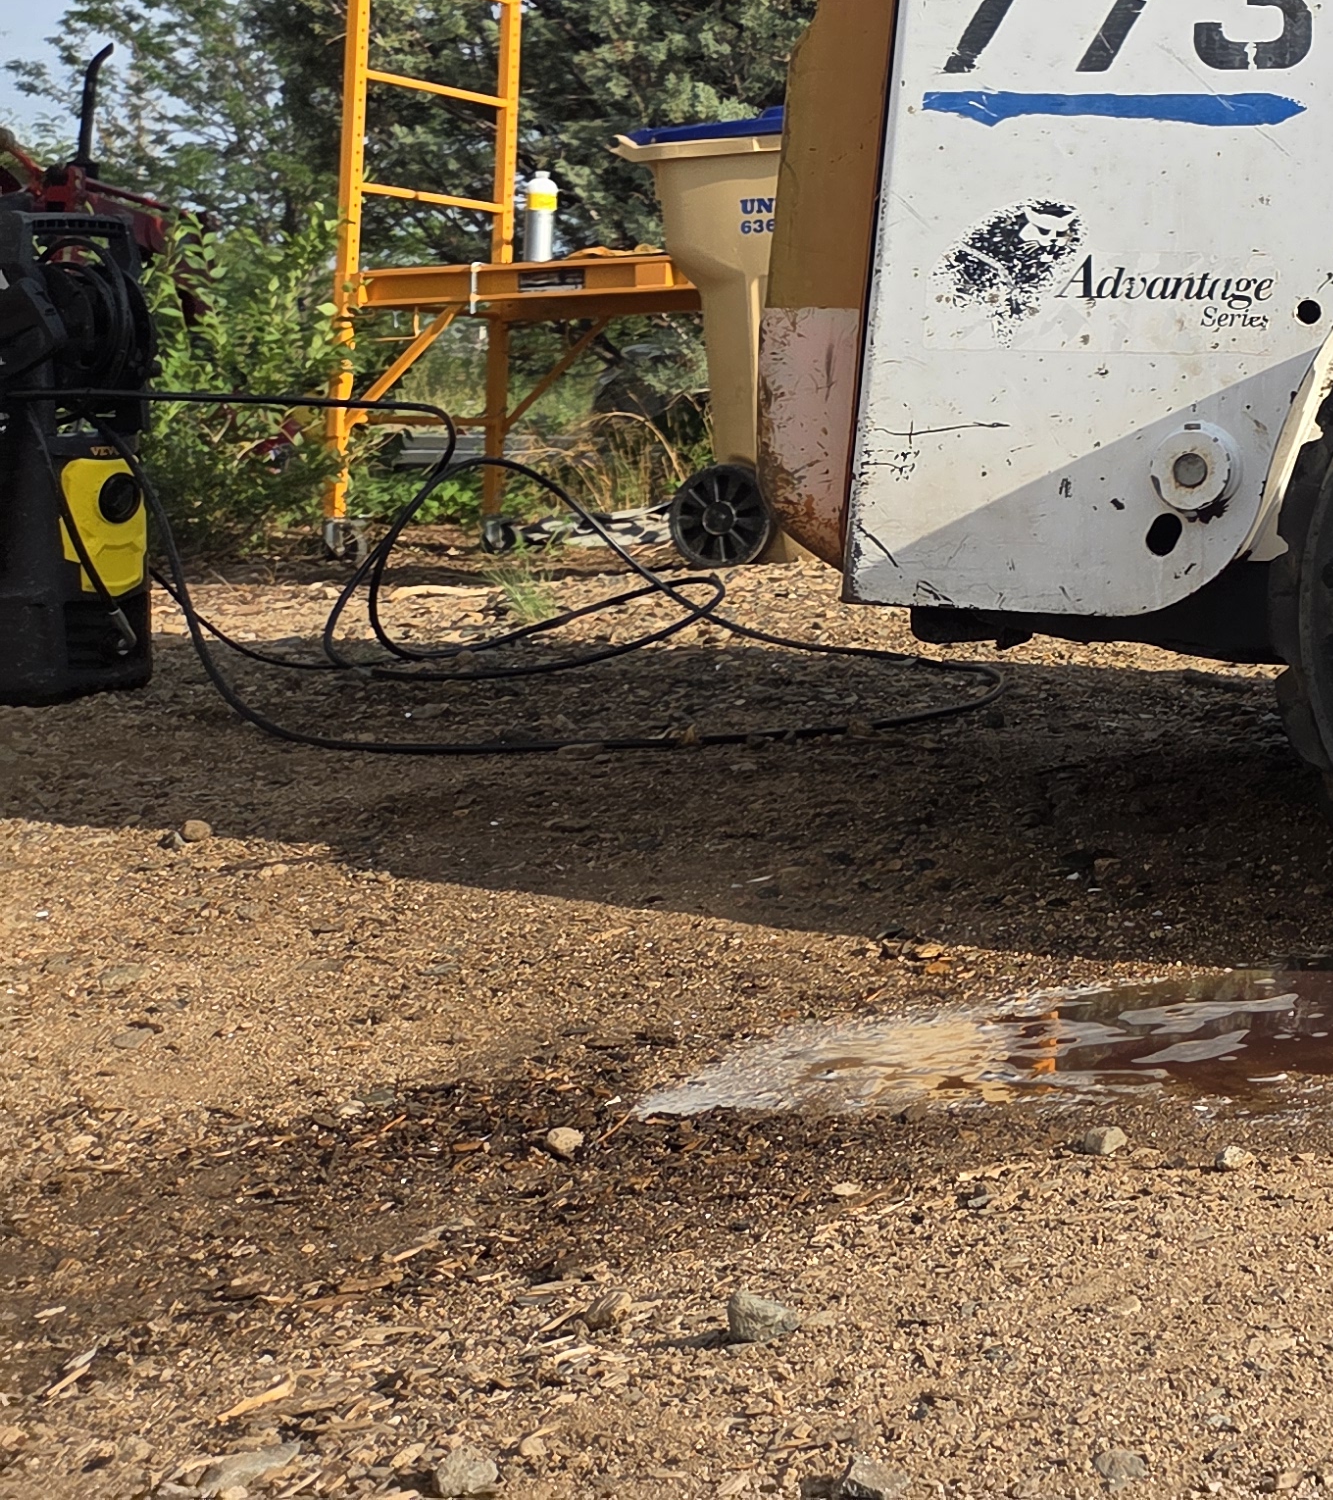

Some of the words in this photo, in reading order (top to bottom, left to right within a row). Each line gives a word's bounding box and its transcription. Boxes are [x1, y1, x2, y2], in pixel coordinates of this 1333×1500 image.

[740, 197, 776, 216] UN
[1053, 254, 1275, 310] Advantage
[1200, 305, 1269, 330] Series
